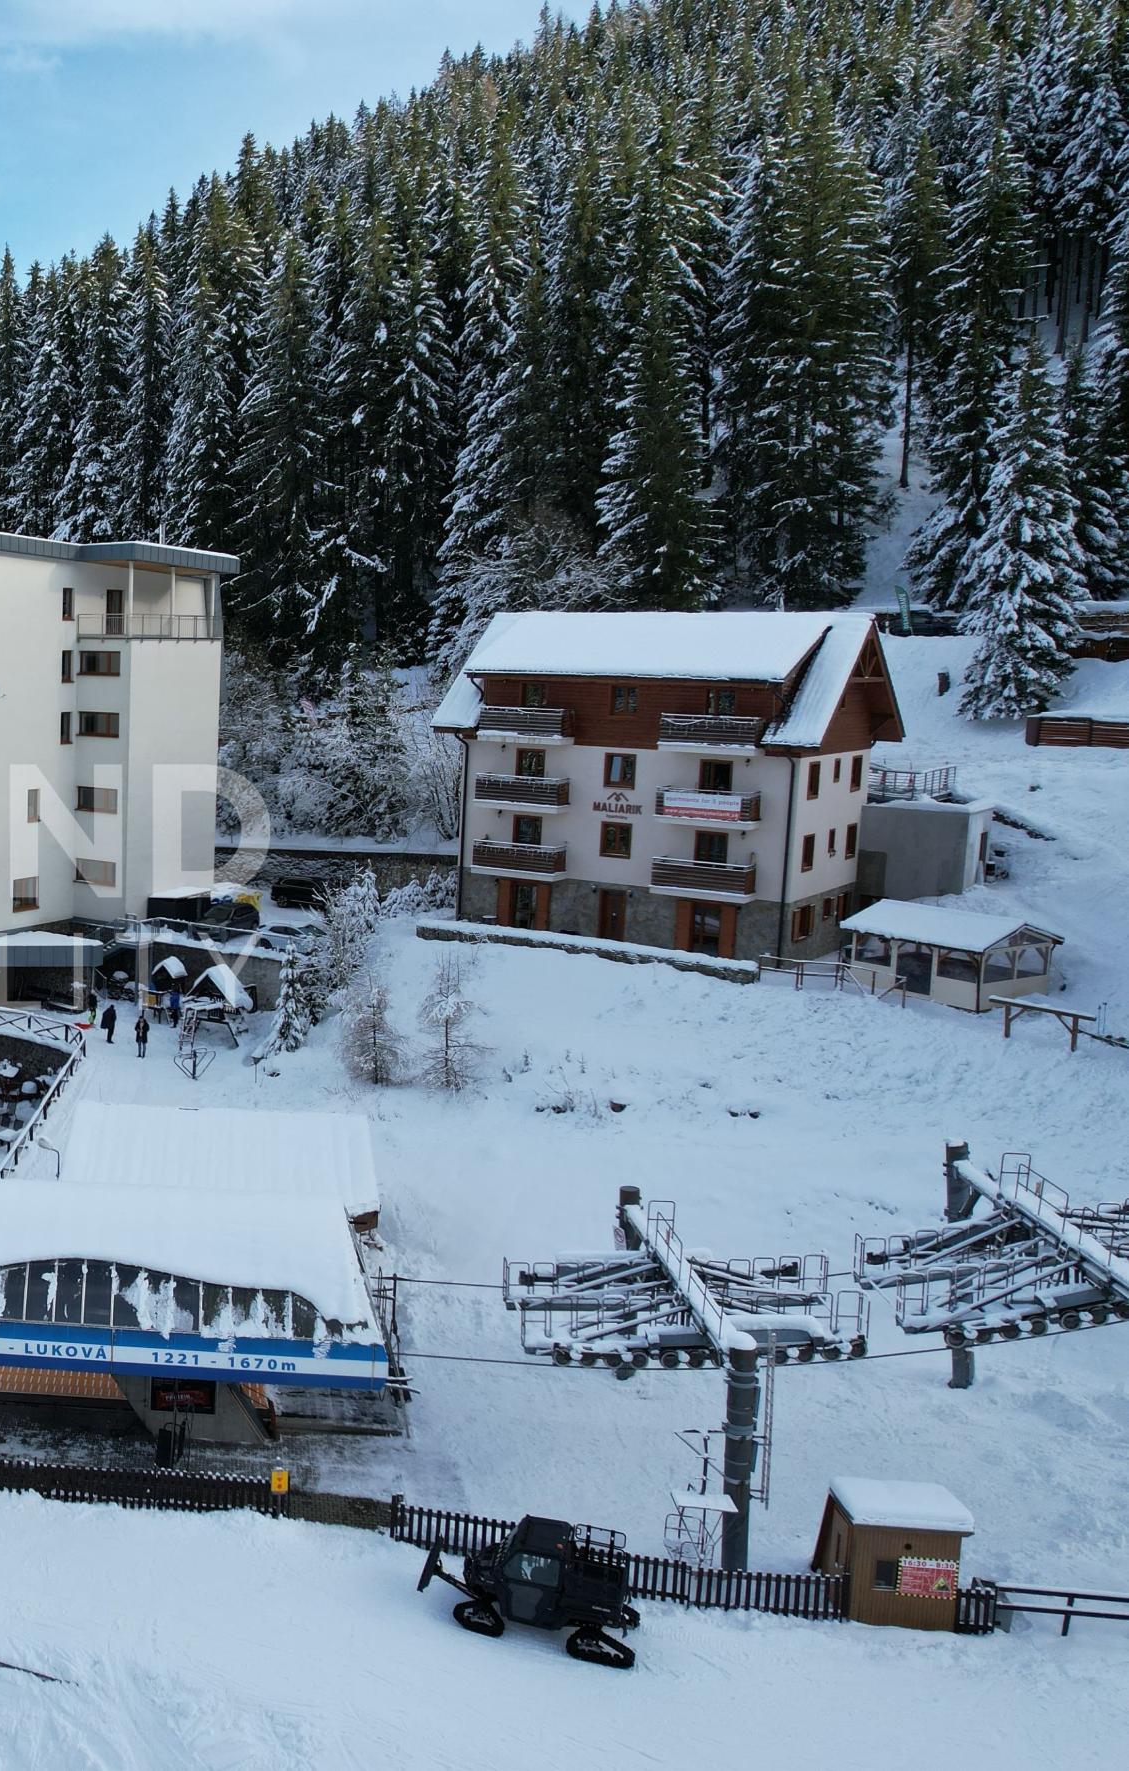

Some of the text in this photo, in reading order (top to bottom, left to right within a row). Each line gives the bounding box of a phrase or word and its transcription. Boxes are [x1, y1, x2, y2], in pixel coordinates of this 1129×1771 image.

[592, 801, 643, 815] MALIARIK
[24, 1342, 107, 1360] LUKOVÁ
[151, 1352, 199, 1366] 1221
[228, 1356, 297, 1371] 1670m
